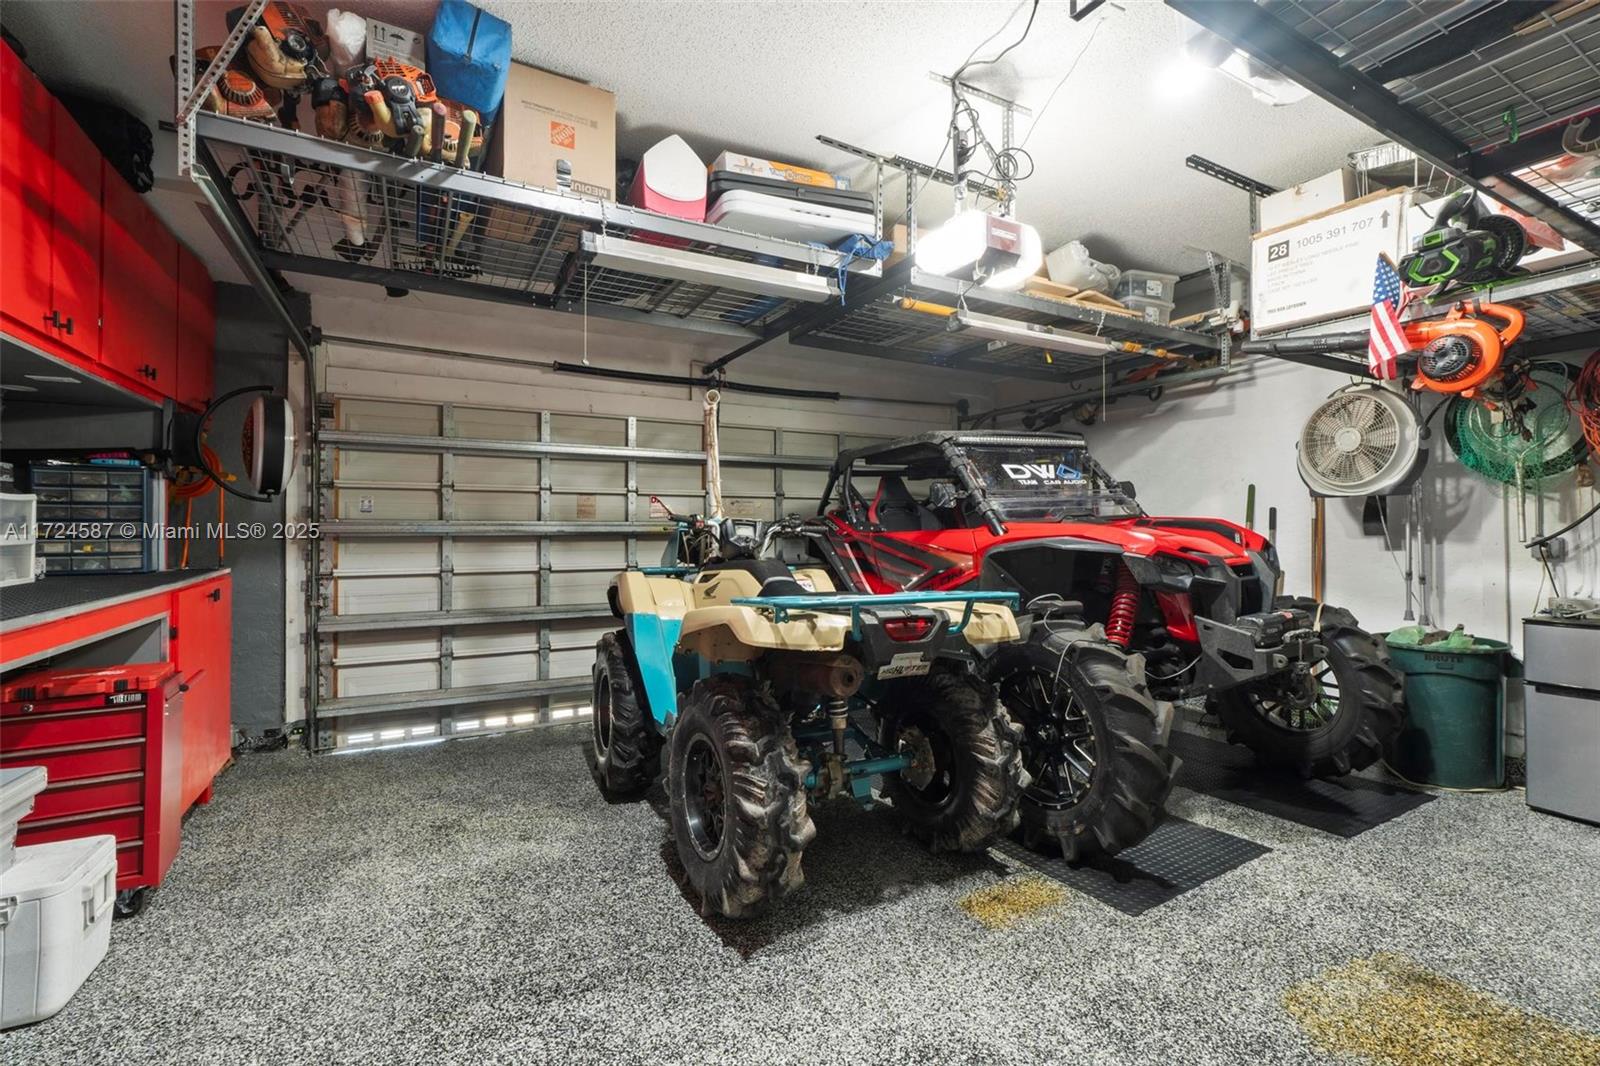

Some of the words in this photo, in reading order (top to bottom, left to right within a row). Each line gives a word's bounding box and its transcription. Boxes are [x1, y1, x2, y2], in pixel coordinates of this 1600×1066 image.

[571, 180, 608, 198] MEDIU
[1296, 233, 1323, 249] 1005
[1326, 226, 1347, 240] 391
[1352, 217, 1374, 232] 707
[1269, 244, 1288, 260] 28
[1424, 653, 1464, 663] BRUTE
